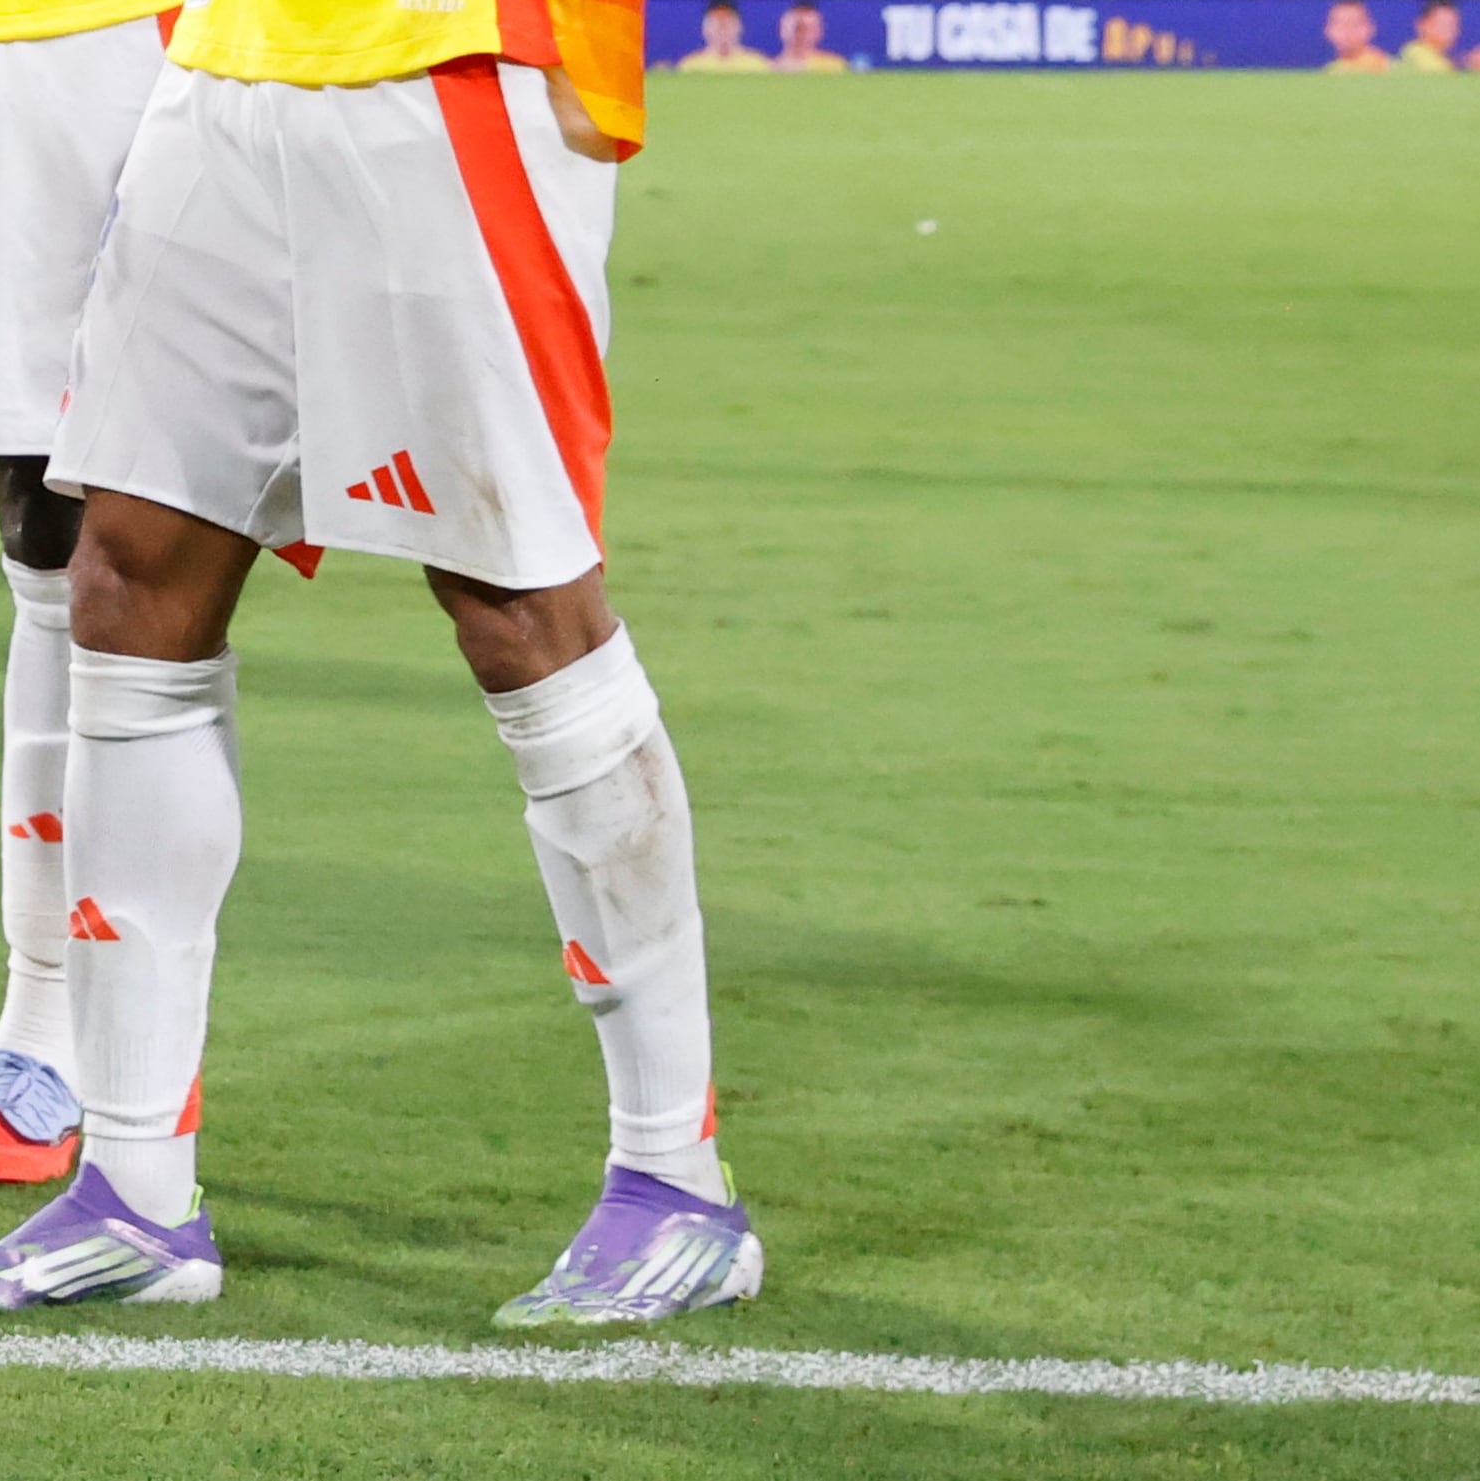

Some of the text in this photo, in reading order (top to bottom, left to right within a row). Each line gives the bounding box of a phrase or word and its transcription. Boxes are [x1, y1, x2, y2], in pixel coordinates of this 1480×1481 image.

[882, 4, 936, 62] TU
[938, 2, 1038, 62] CASA
[1042, 4, 1099, 62] DE
